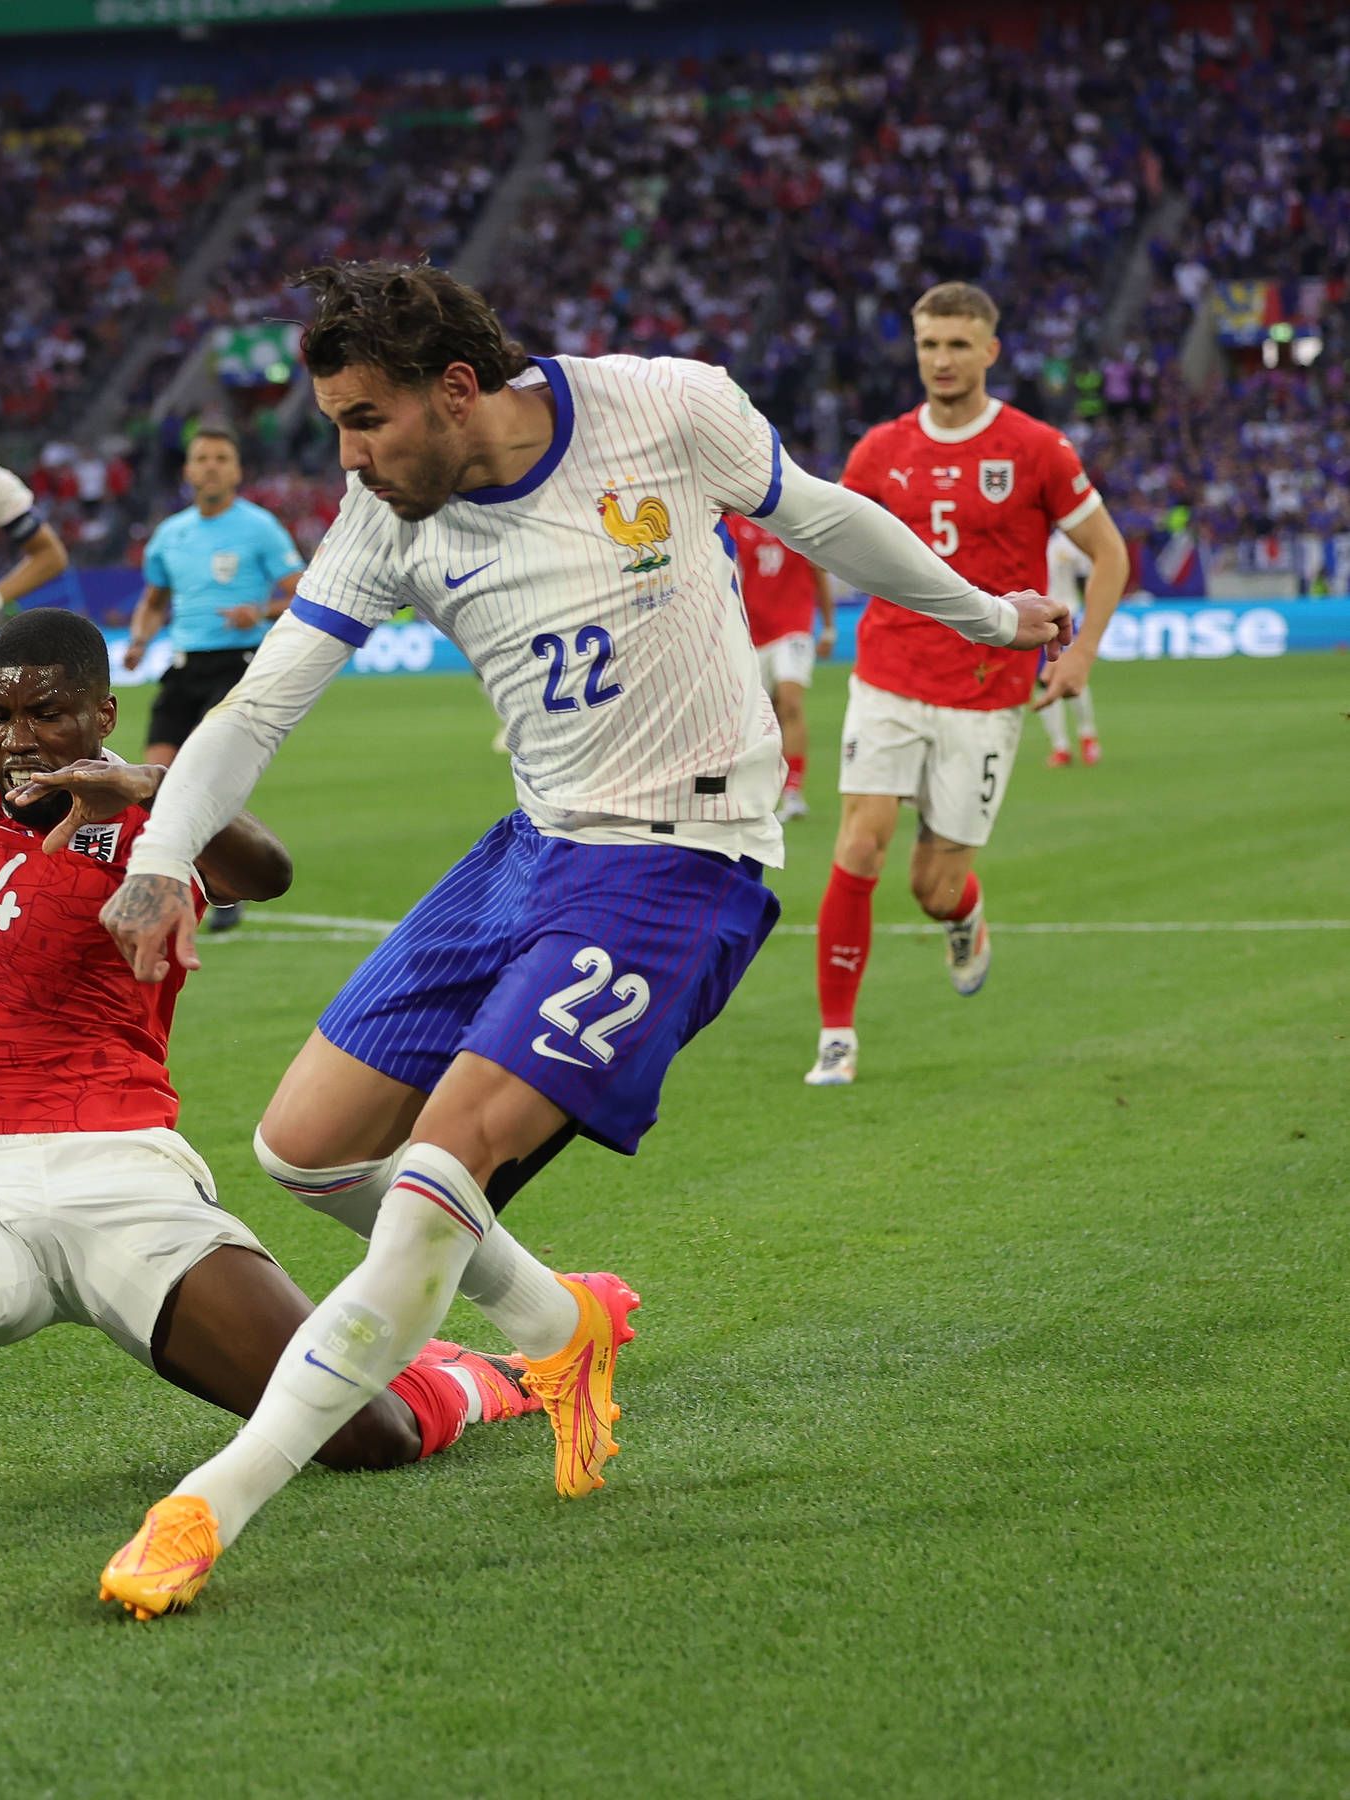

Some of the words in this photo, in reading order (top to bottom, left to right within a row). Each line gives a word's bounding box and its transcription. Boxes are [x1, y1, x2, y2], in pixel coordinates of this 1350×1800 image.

[931, 500, 959, 557] 5
[531, 624, 624, 714] 22
[981, 753, 999, 803] 5
[539, 946, 650, 1064] 22
